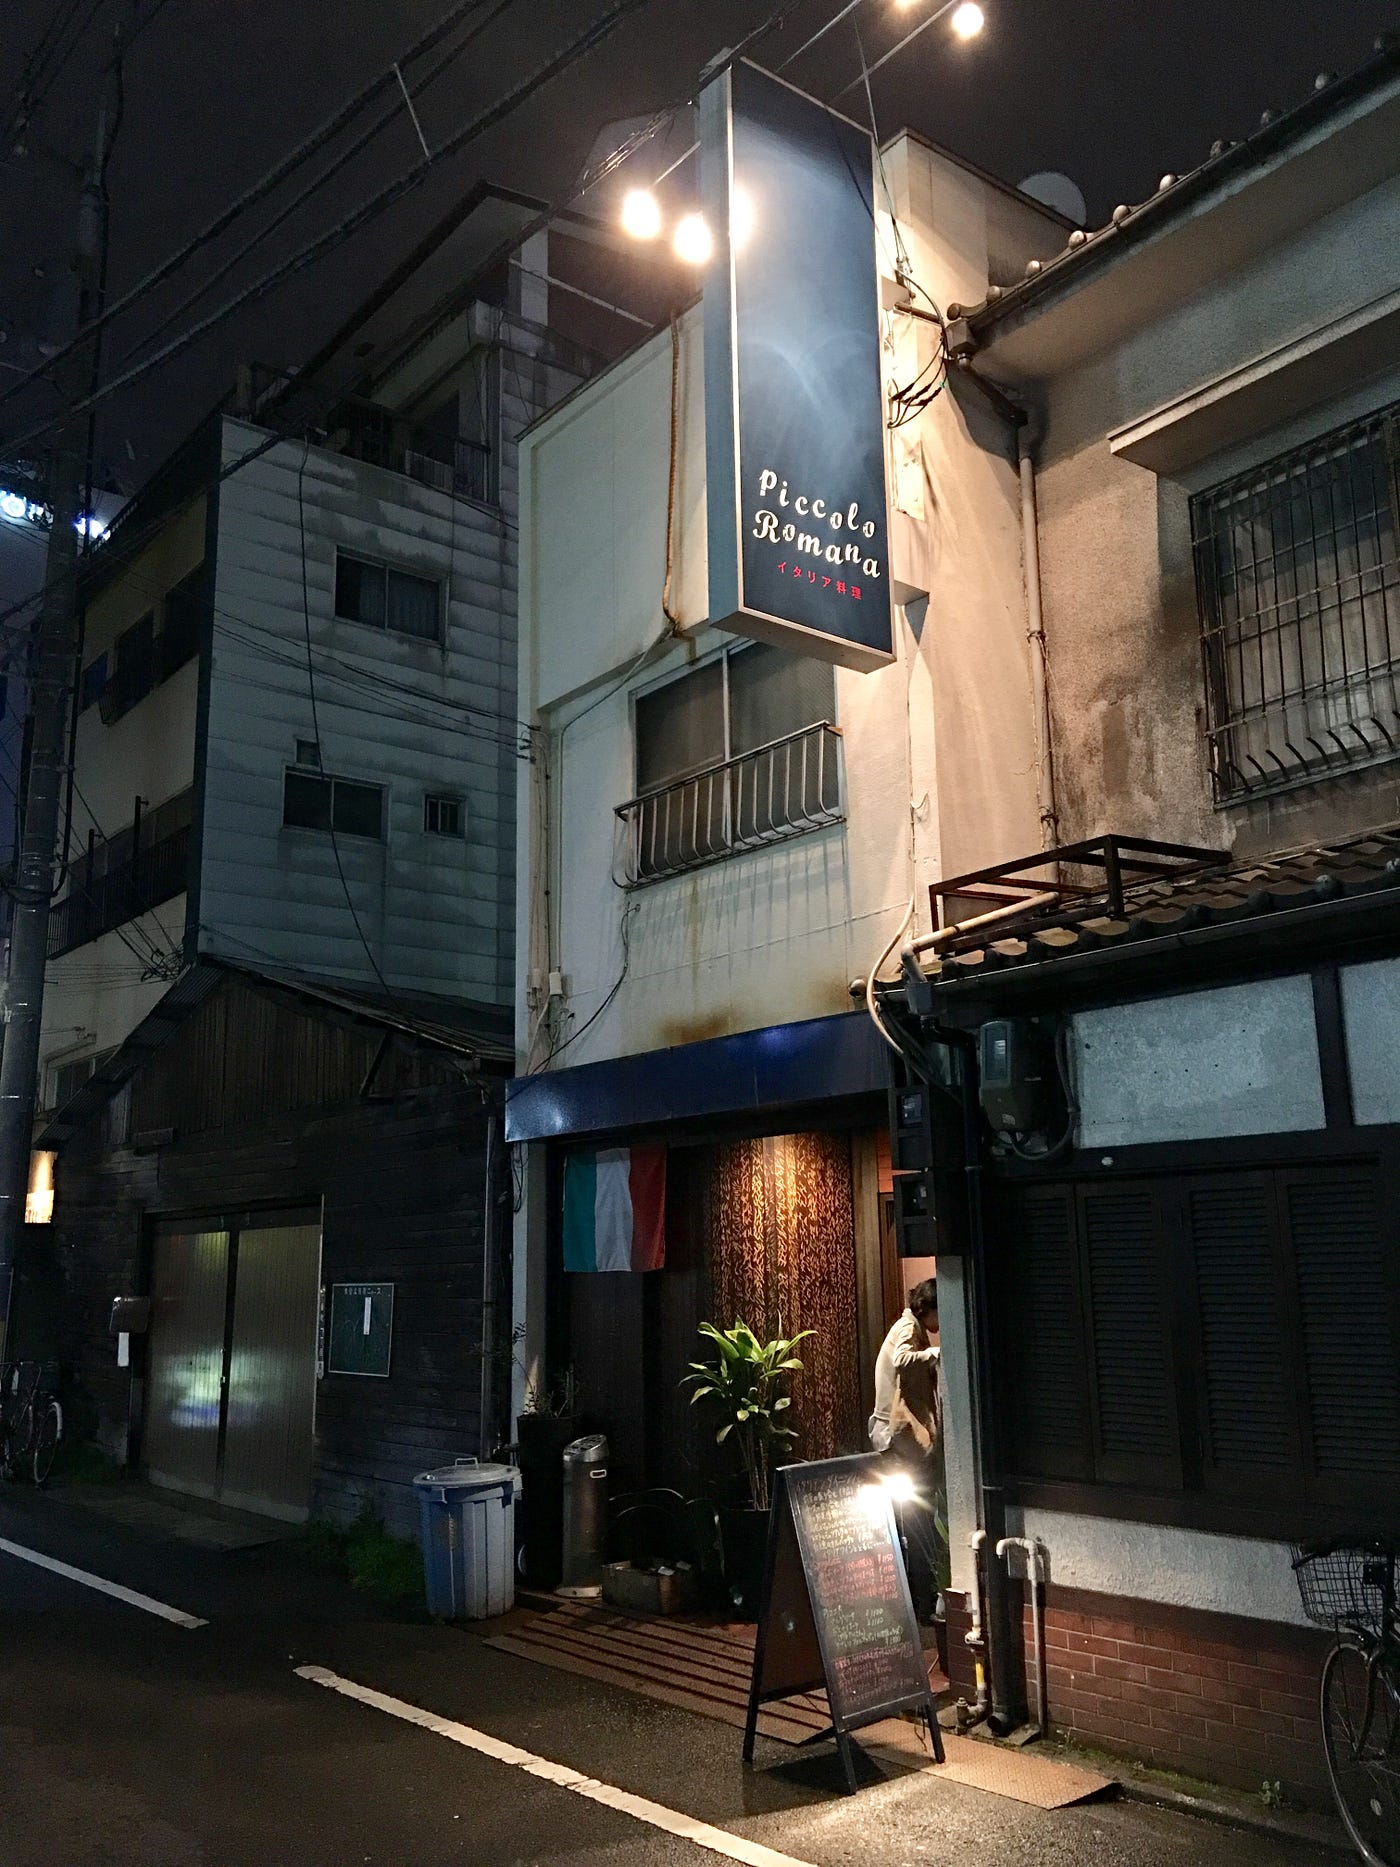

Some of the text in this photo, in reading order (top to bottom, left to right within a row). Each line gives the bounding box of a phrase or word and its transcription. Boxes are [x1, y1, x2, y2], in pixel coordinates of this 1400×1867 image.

[759, 469, 875, 538] Piccolo
[752, 509, 881, 578] Romana
[777, 562, 863, 600] イタリア料理
